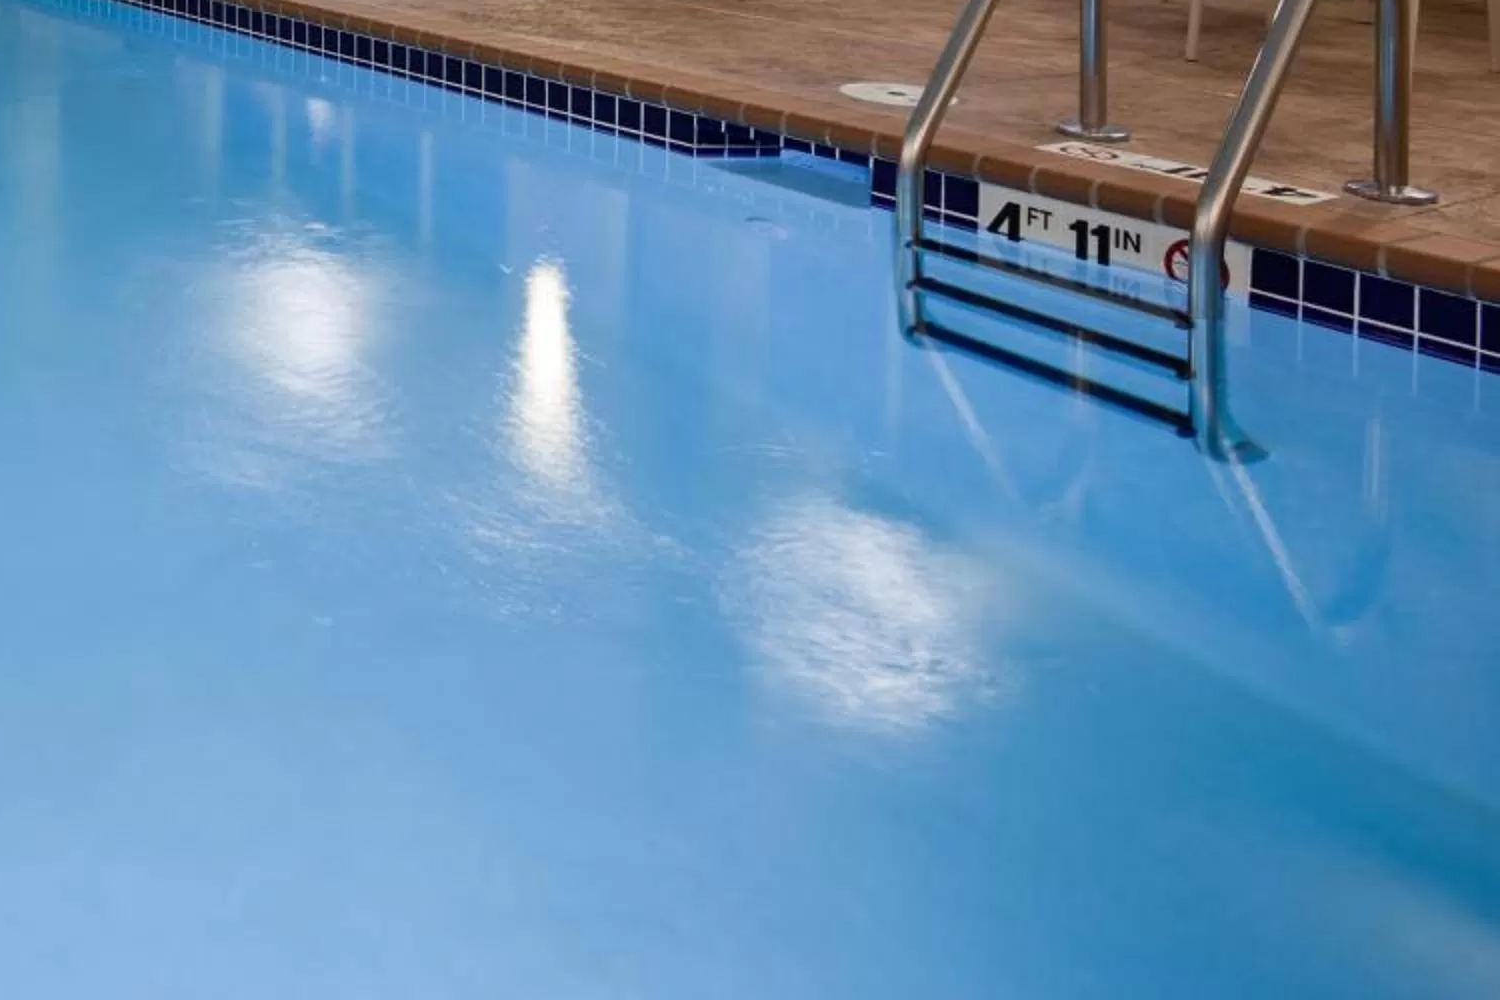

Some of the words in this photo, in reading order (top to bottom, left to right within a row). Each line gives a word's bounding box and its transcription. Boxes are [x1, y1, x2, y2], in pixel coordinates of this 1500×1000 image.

[987, 201, 1023, 242] 4
[1027, 206, 1052, 230] FT
[1068, 219, 1111, 266] 11
[1115, 227, 1141, 253] IN
